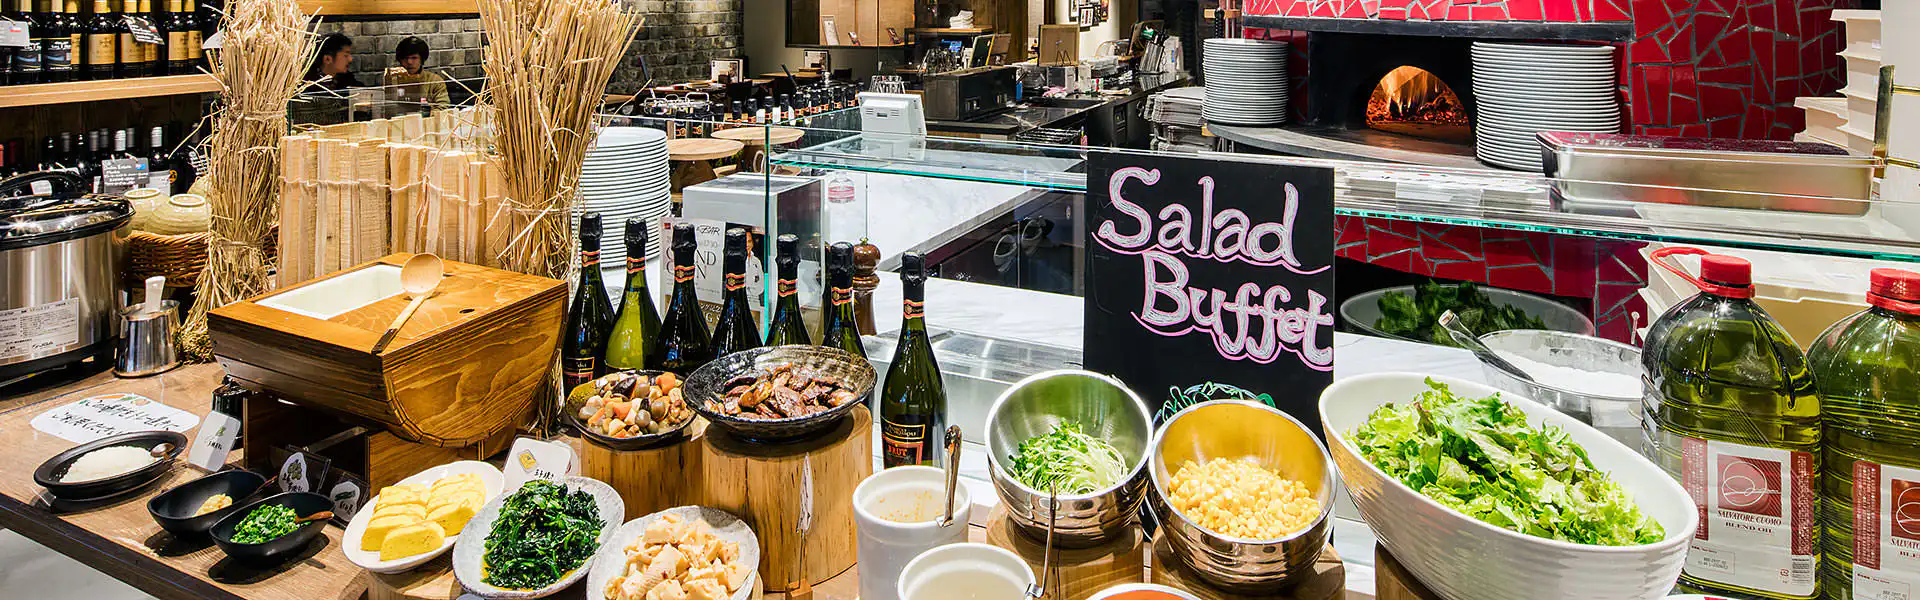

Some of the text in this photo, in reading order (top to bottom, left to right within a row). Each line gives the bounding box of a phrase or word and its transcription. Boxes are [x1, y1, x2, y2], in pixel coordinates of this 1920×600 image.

[1098, 166, 1302, 267] Salad
[1141, 250, 1335, 366] Buffet
[1717, 509, 1782, 526] SALVATORE CUOMO
[1725, 521, 1773, 534] BLEND OIL
